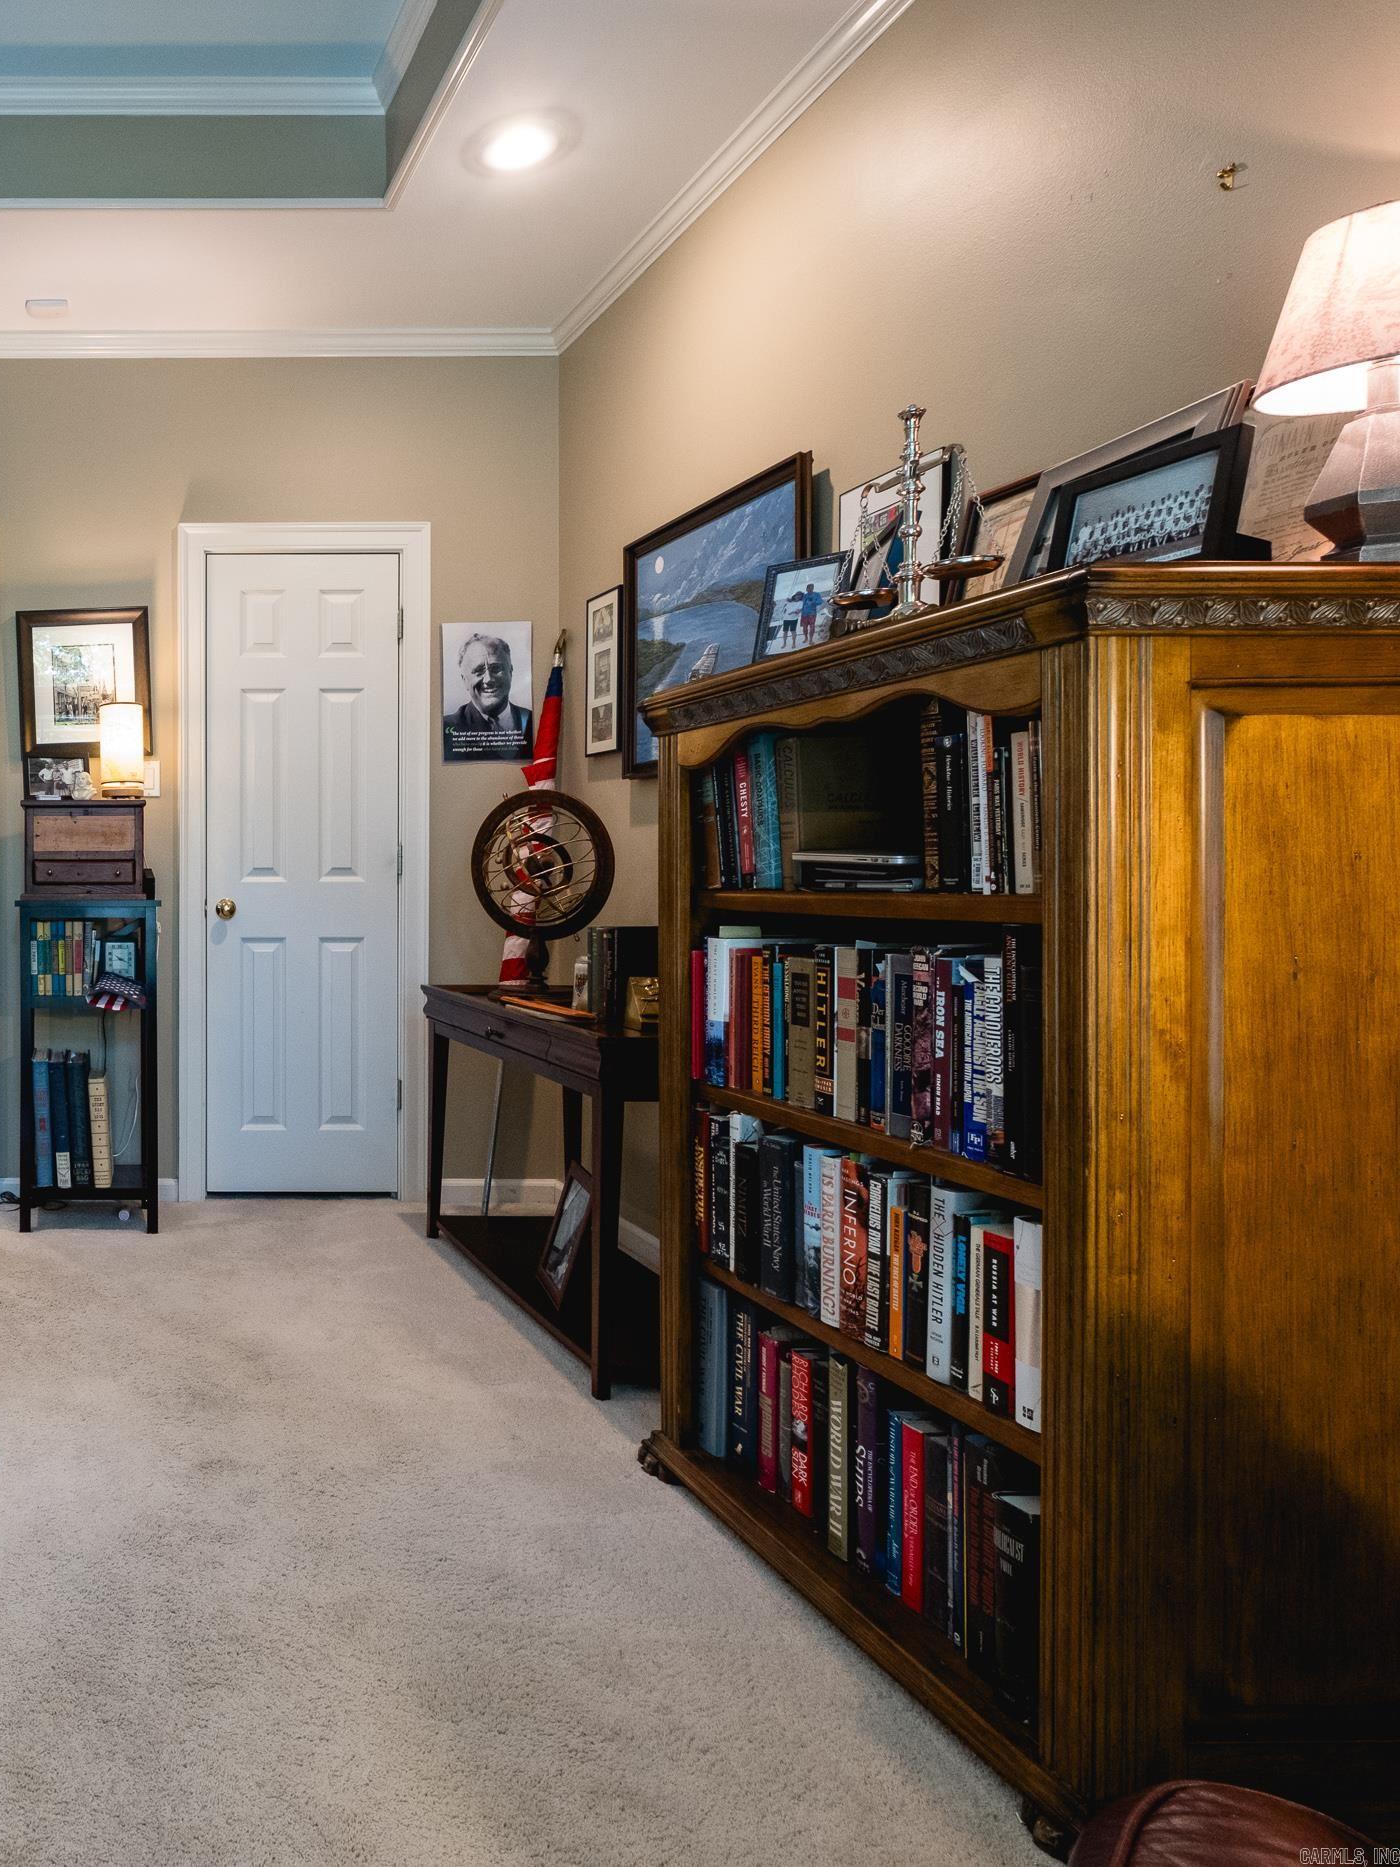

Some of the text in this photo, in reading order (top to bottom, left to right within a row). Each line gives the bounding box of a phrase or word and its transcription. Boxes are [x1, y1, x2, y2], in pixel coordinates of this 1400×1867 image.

[740, 782, 748, 818] CHESTY
[754, 754, 764, 826] BASIC GRAPHICS
[900, 979, 908, 1015] Manchester
[984, 967, 1002, 993] THE
[763, 984, 771, 1025] GERMAN
[935, 990, 945, 1059] IRON SEA
[763, 1026, 772, 1056] ARMY
[894, 1022, 903, 1072] DARKNESS
[904, 1025, 912, 1072] GOODBYE
[963, 999, 972, 1103] THE AMERICAN WAR WITH JAPAN
[973, 982, 985, 1123] EAGLE AGAINST THE SUN
[985, 994, 1002, 1085] CONQUERORS
[762, 1188, 772, 1247] World War II
[772, 1179, 782, 1214] United
[934, 1197, 945, 1219] THE
[772, 1214, 782, 1244] States
[822, 1173, 835, 1316] IS PARIS BURNING?
[843, 1188, 857, 1285] INFERNO
[771, 1246, 782, 1272] Navy
[865, 1180, 881, 1331] CORNELIUS RYAN THE LAST BATTLE
[932, 1233, 944, 1278] HIDDEN
[956, 1234, 966, 1315] LONELY VIGIL
[931, 1281, 943, 1325] HITLER
[992, 1293, 998, 1304] AT
[734, 1311, 743, 1416] THE CIVIL WAR
[791, 1353, 800, 1416] RHODES
[799, 1359, 808, 1423] RICHARD
[758, 1392, 772, 1459] Memoirs
[888, 1426, 896, 1465] HISTORY
[799, 1451, 808, 1487] DARK
[829, 1399, 842, 1537] WORLD WAR II
[854, 1443, 866, 1508] SHIPS
[908, 1465, 918, 1488] END
[888, 1476, 896, 1522] WARFARE
[908, 1499, 918, 1535] ORDER
